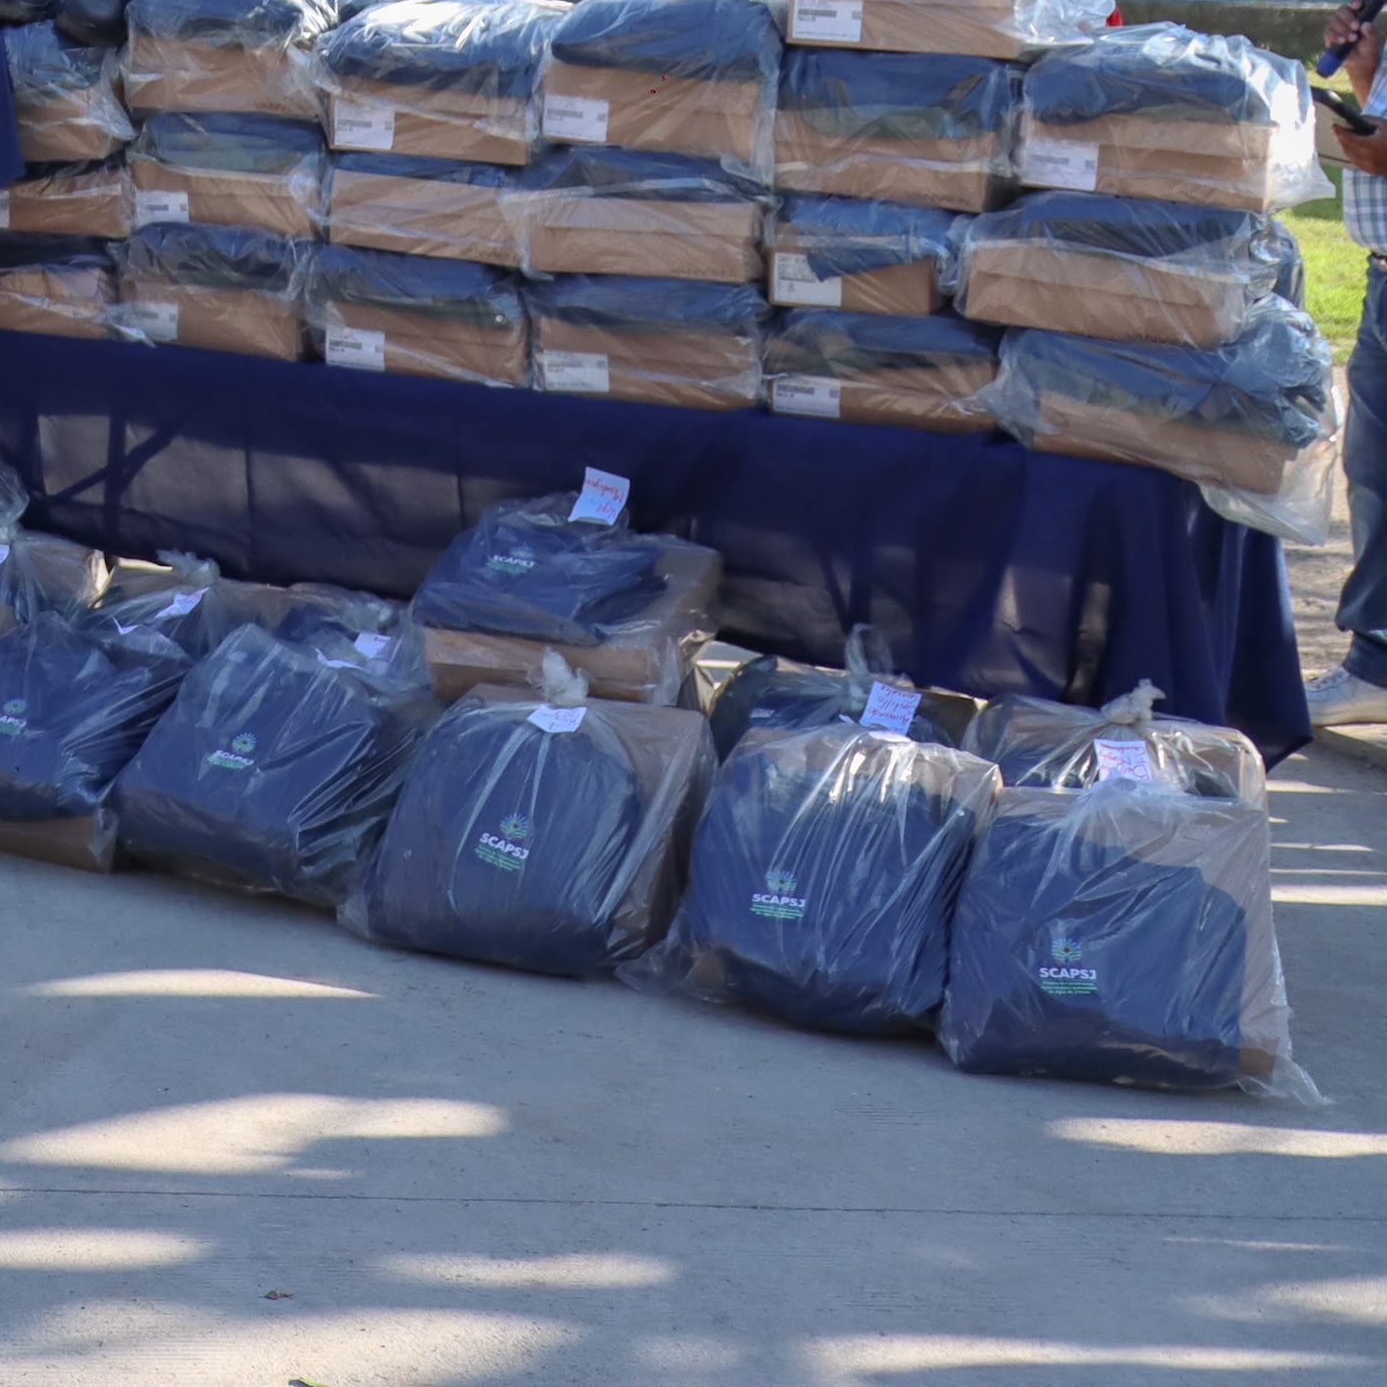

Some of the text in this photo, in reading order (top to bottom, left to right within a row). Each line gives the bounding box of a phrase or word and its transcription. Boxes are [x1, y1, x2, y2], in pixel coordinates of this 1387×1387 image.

[479, 832, 529, 860] SCAPSJ
[751, 893, 806, 908] SCAPSJ
[1039, 967, 1097, 980] SCAPSJ
